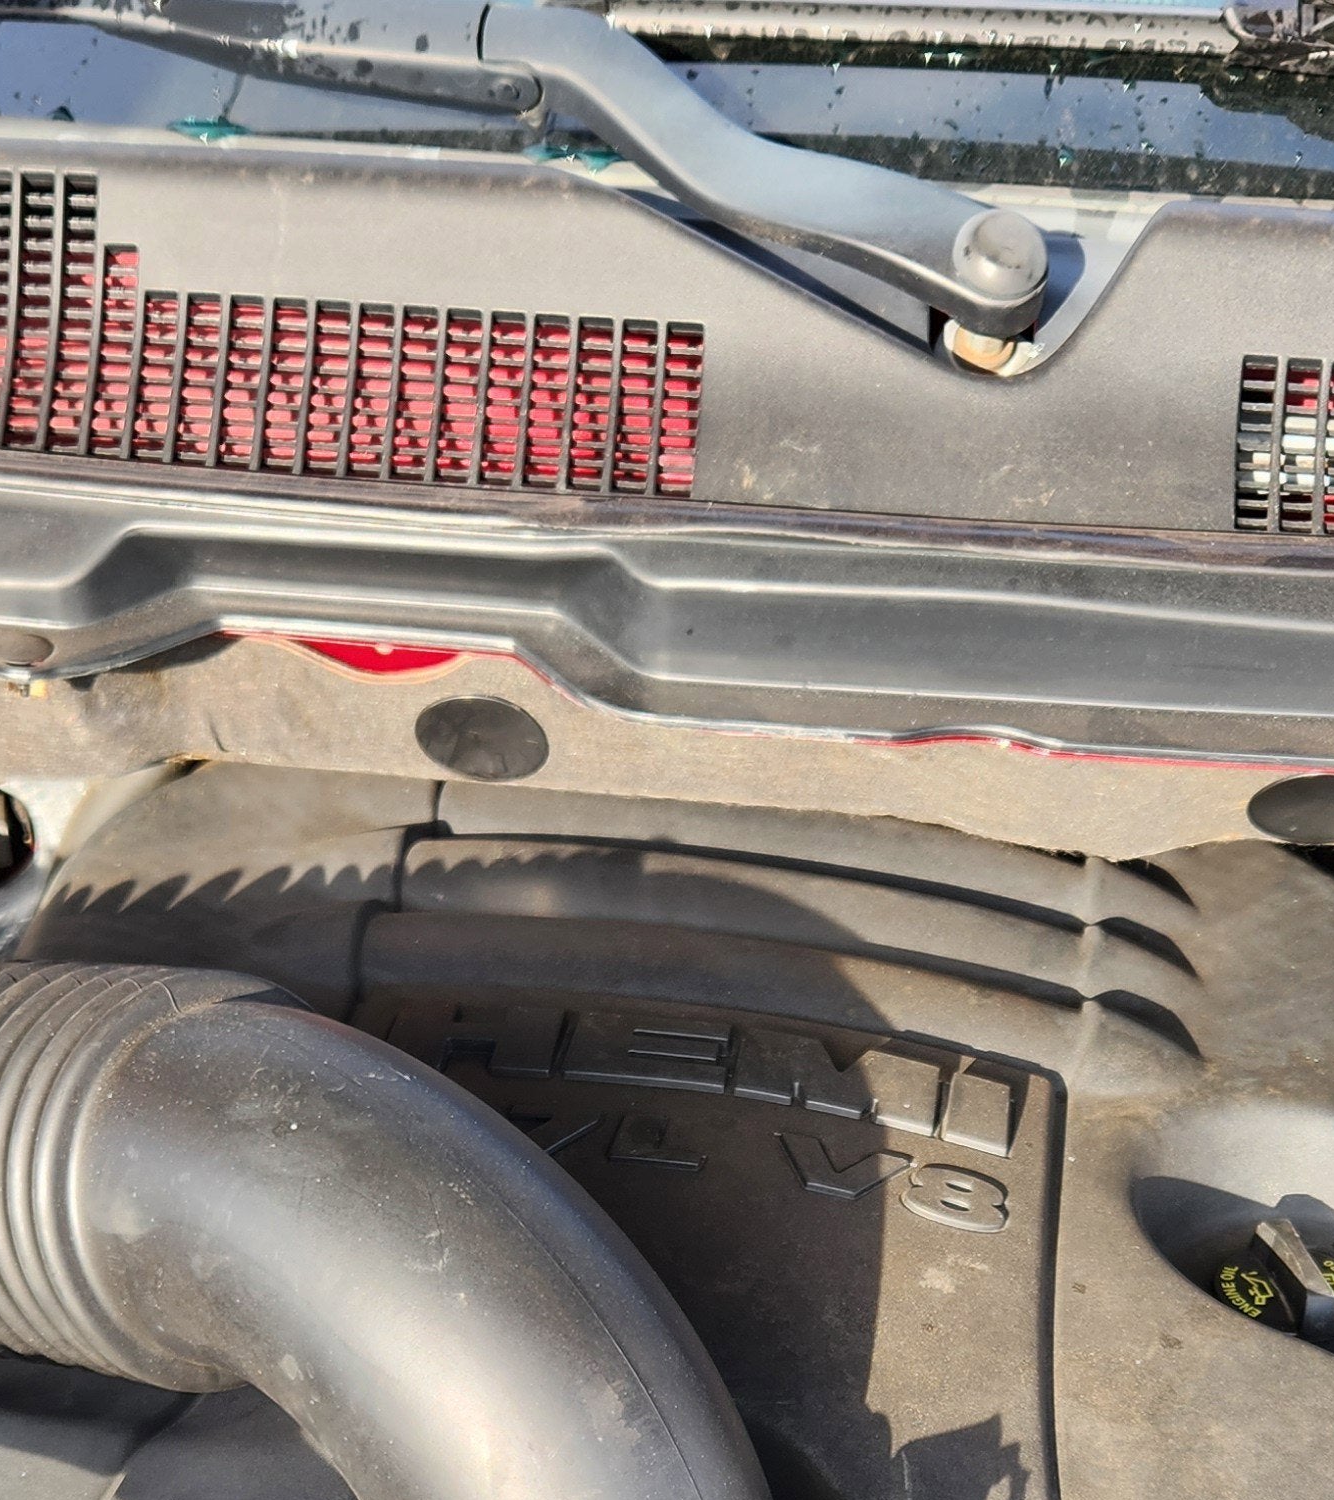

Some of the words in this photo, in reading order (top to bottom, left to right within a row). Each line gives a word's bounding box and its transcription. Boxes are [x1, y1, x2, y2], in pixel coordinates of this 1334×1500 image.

[389, 1003, 1025, 1158] HEMI
[772, 1130, 1010, 1234] V8
[1220, 1265, 1239, 1281] OIL
[1221, 1281, 1262, 1318] ENGINE
